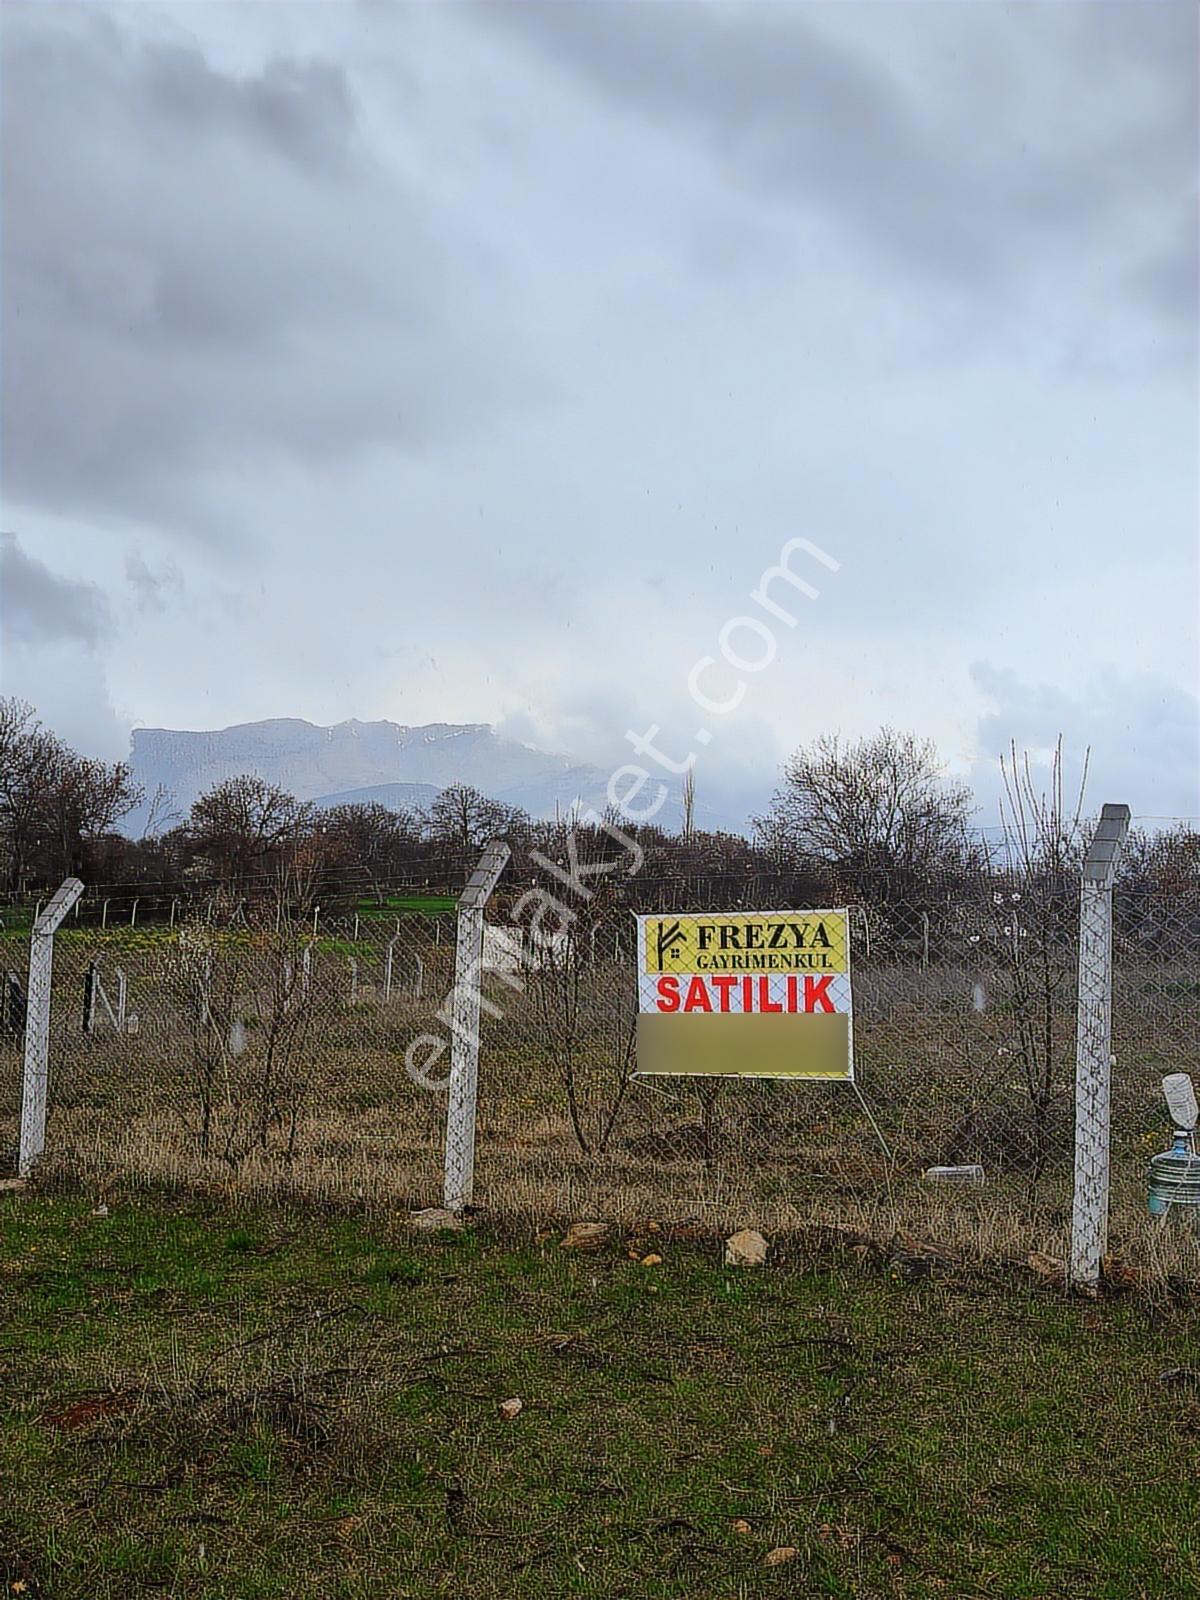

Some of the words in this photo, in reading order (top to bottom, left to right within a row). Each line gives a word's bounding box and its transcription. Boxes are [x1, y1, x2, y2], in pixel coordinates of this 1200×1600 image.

[697, 922, 833, 950] FREZYA
[696, 951, 833, 970] GAYRİMENKUL
[656, 975, 836, 1013] SATILIK
